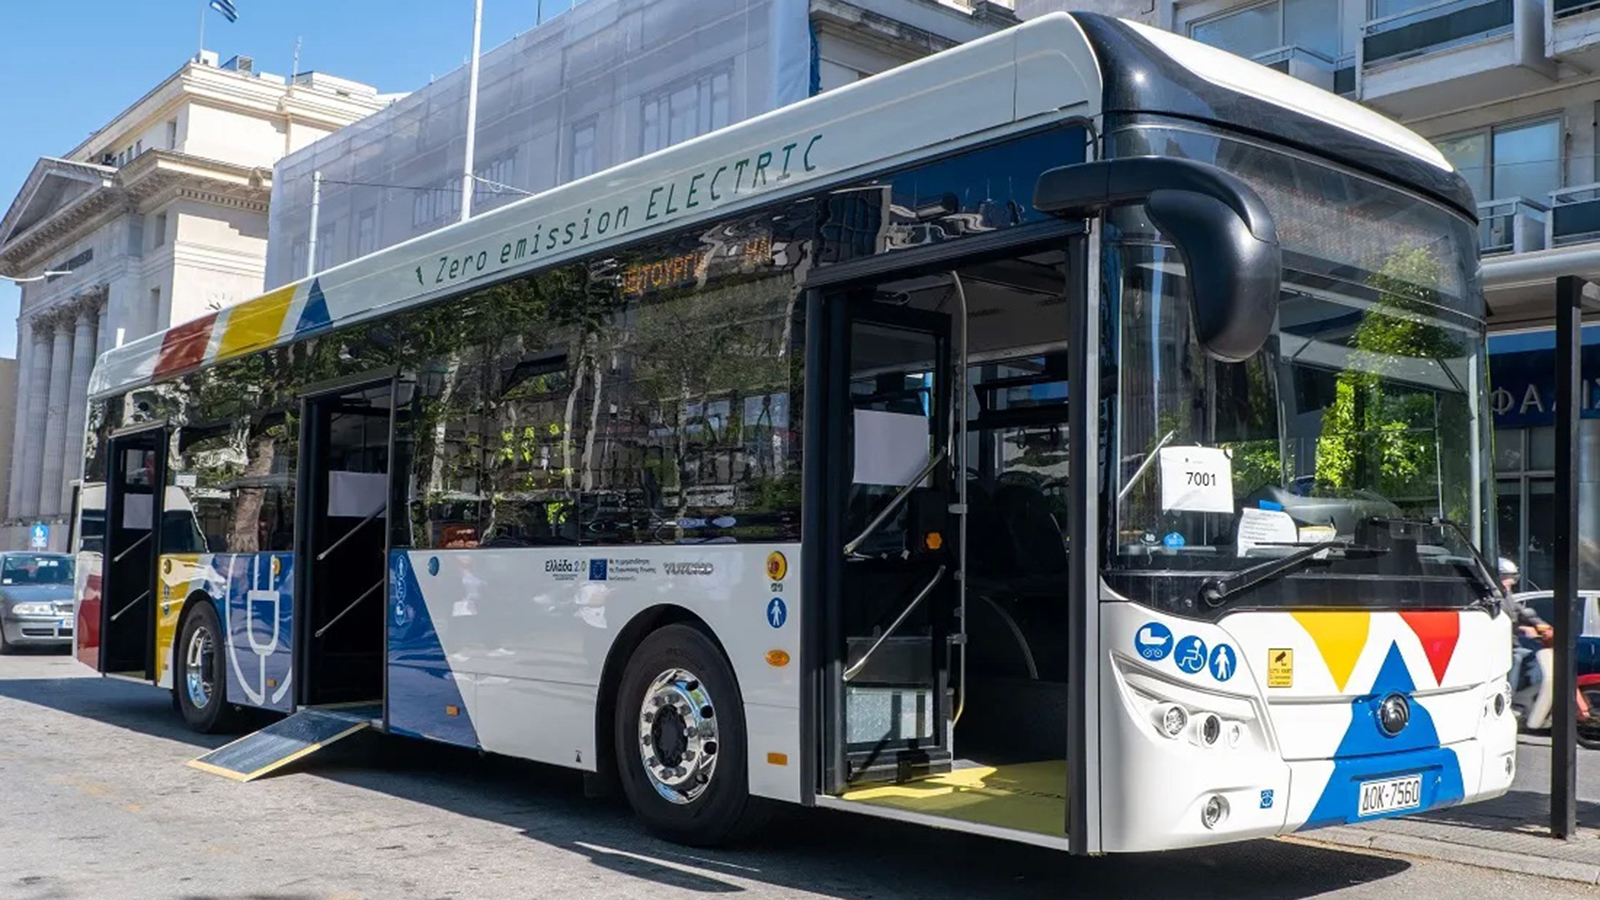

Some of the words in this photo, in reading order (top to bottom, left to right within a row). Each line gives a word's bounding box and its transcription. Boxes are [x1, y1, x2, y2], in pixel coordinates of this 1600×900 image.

[435, 251, 488, 284] Zero
[499, 204, 629, 264] emission
[645, 134, 823, 221] ELECTRIC
[1185, 471, 1216, 487] 7001
